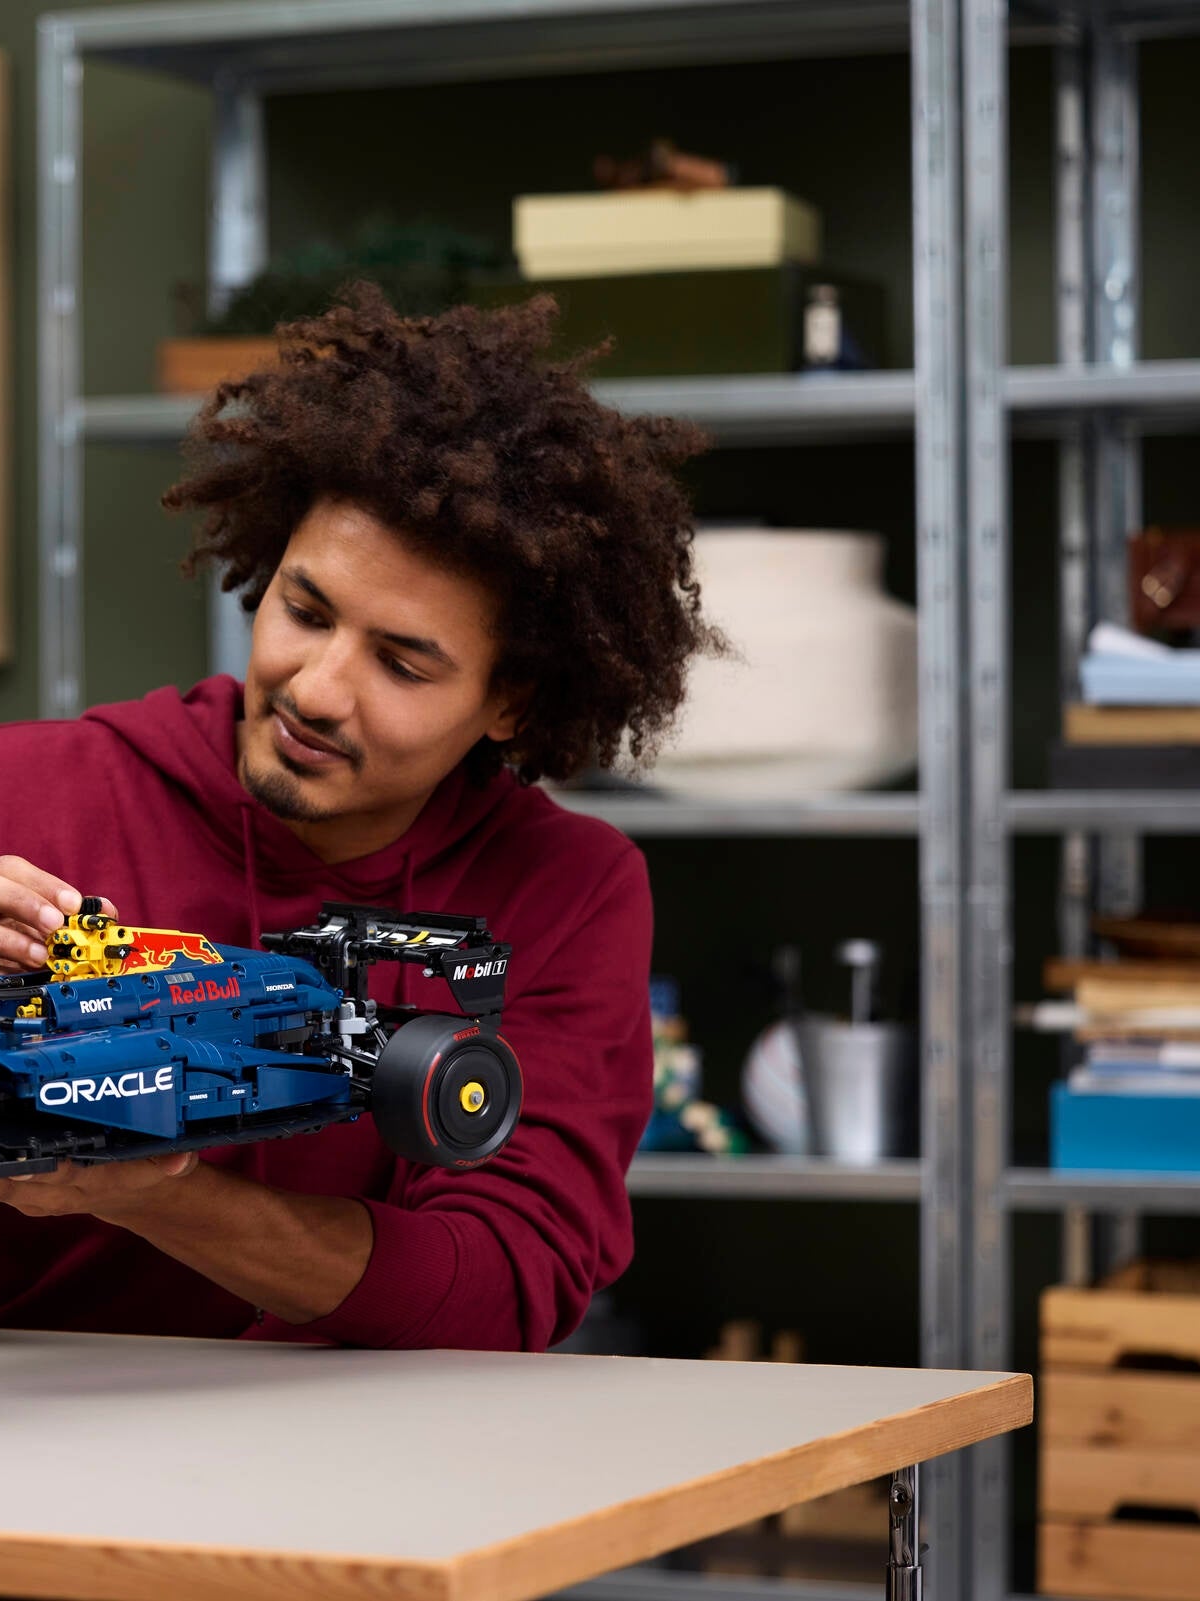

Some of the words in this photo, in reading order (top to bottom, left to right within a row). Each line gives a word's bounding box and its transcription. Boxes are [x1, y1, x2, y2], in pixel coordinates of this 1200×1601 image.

[453, 962, 492, 980] Mobil
[170, 981, 205, 1005] Red
[205, 977, 241, 1001] Bull
[265, 983, 295, 992] HONDA
[80, 997, 113, 1014] ROKT
[39, 1066, 174, 1106] ORACLE
